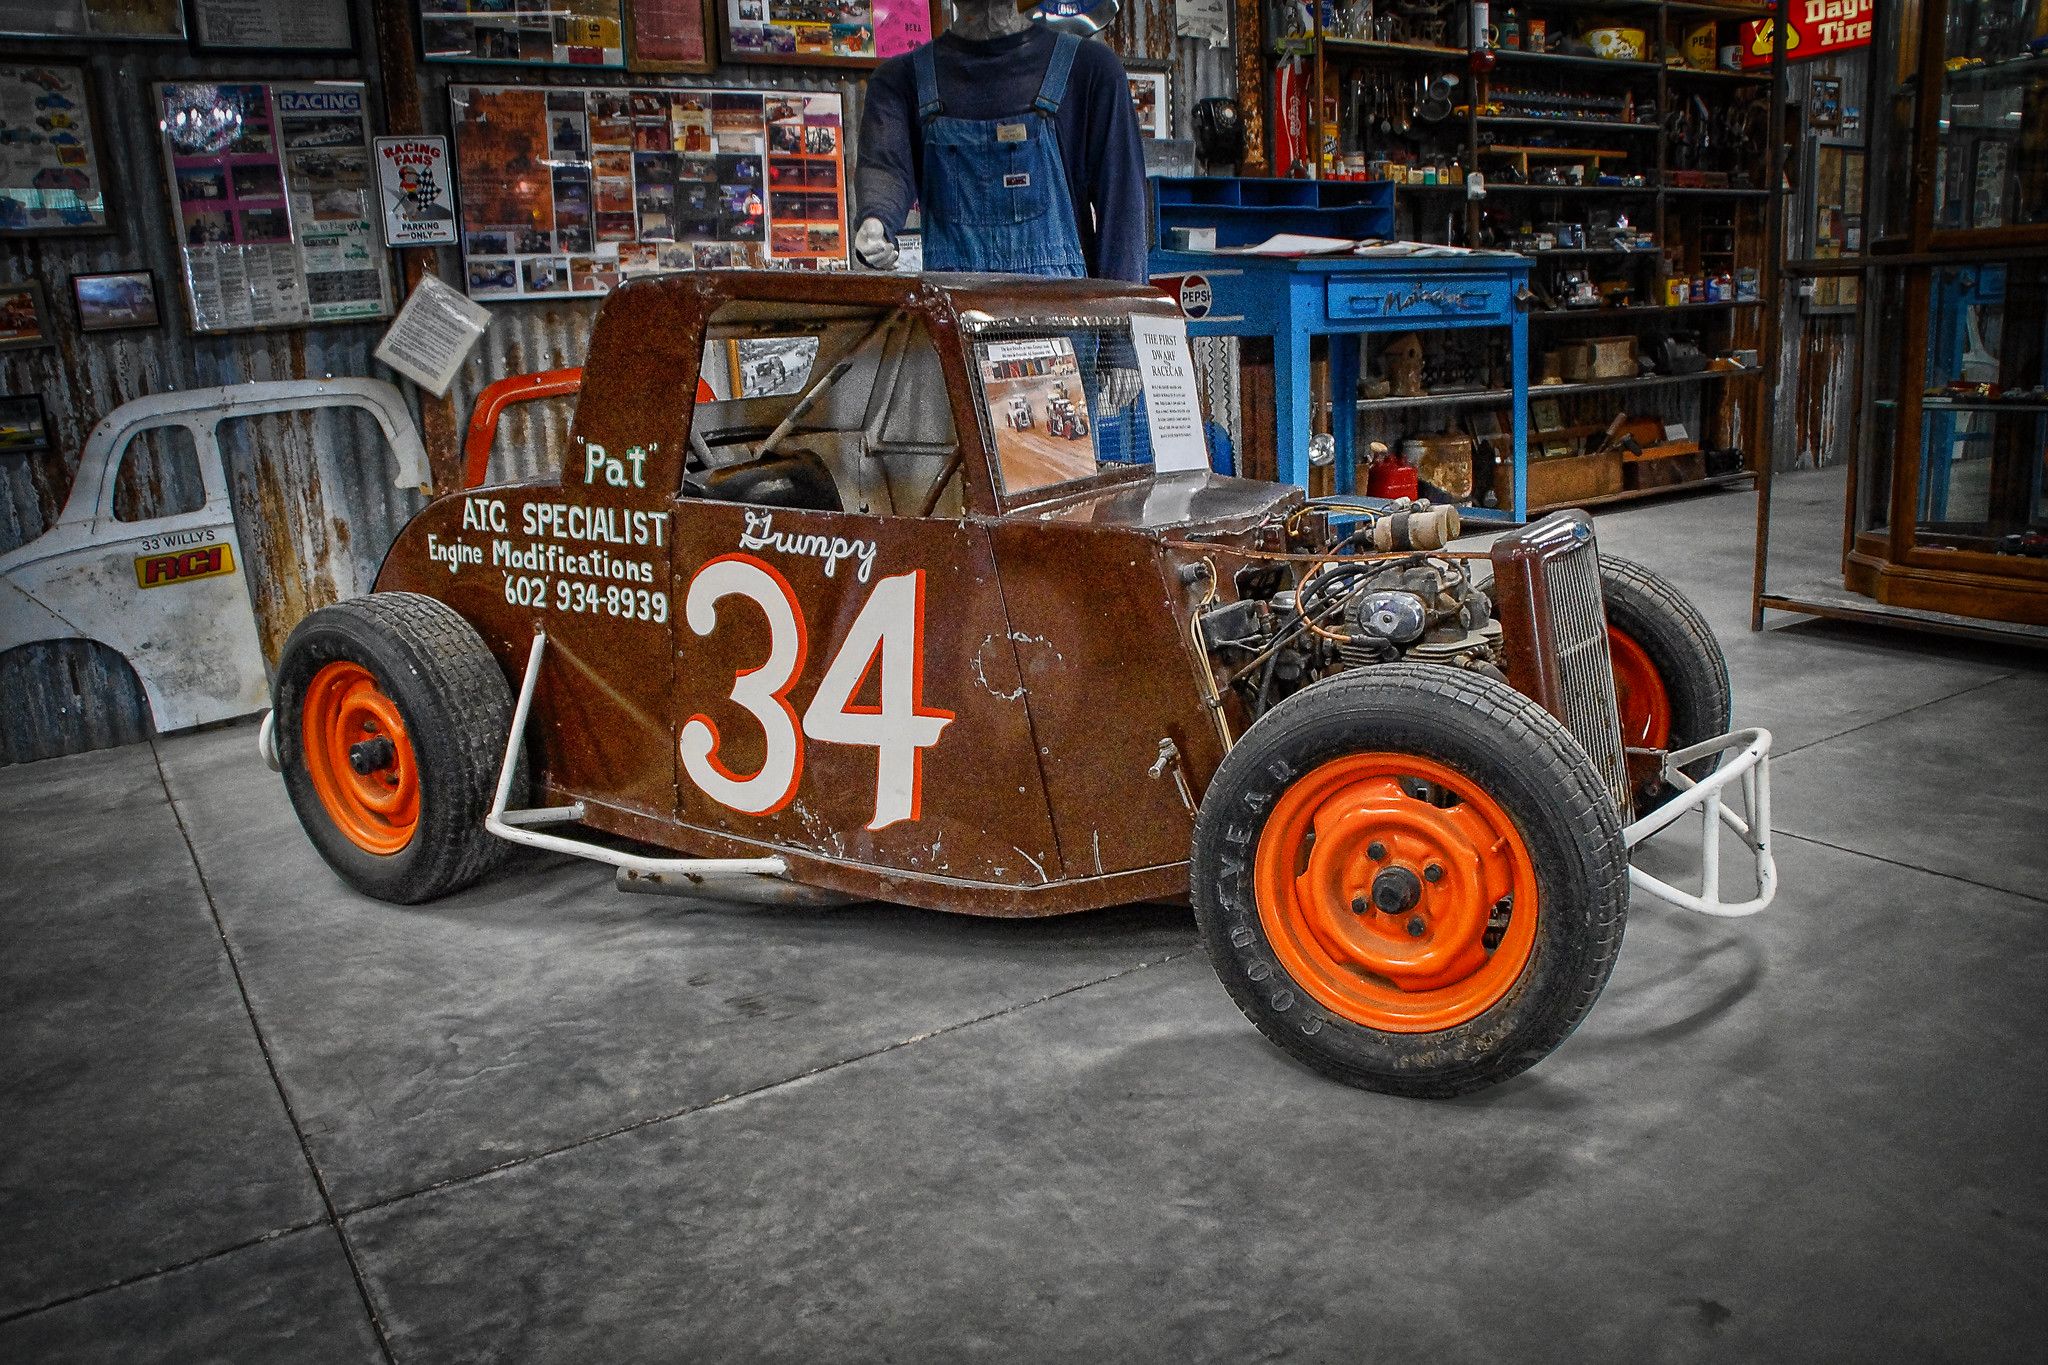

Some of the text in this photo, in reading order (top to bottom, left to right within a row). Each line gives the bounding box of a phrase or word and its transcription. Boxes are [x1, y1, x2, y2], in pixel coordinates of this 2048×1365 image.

[281, 94, 358, 110] RACING
[383, 143, 441, 158] RACING
[394, 154, 432, 167] FANS
[402, 222, 439, 231] PARKING
[410, 231, 433, 239] ONLY
[1143, 333, 1177, 346] THE FIRST
[1151, 349, 1176, 361] DWARF
[1151, 365, 1184, 377] RACECAR
[522, 502, 669, 547] SPECIALIST
[739, 511, 877, 584] Grumpy
[145, 546, 222, 585] RCI
[427, 533, 654, 583] Engine Modifications
[556, 578, 669, 624] 934-8939
[680, 553, 956, 832] 34
